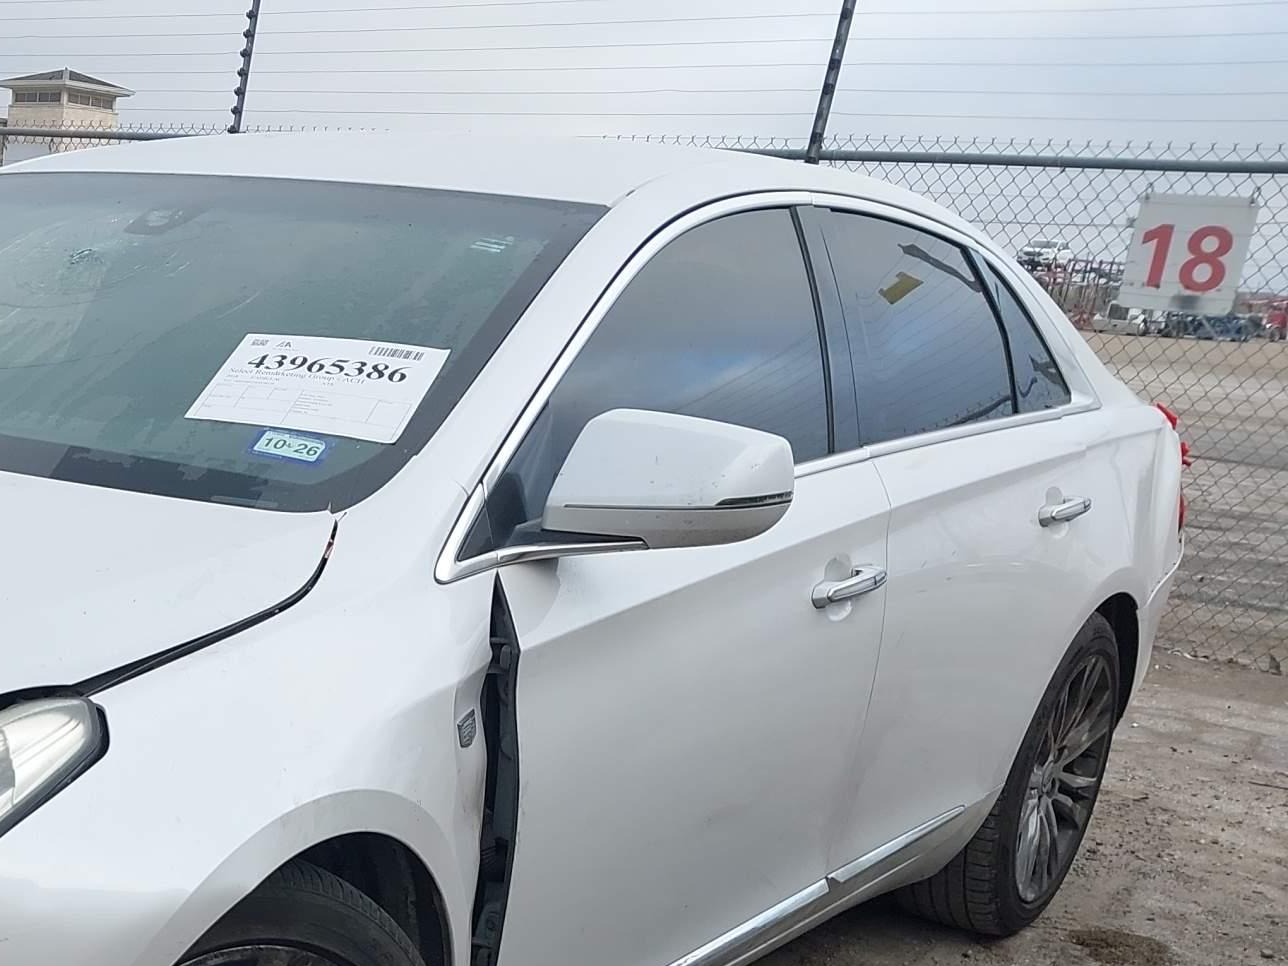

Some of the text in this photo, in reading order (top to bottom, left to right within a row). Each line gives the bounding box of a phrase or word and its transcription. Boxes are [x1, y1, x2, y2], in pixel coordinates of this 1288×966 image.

[1142, 223, 1234, 293] 18
[247, 353, 413, 383] 43965386
[264, 438, 320, 457] 10 26
